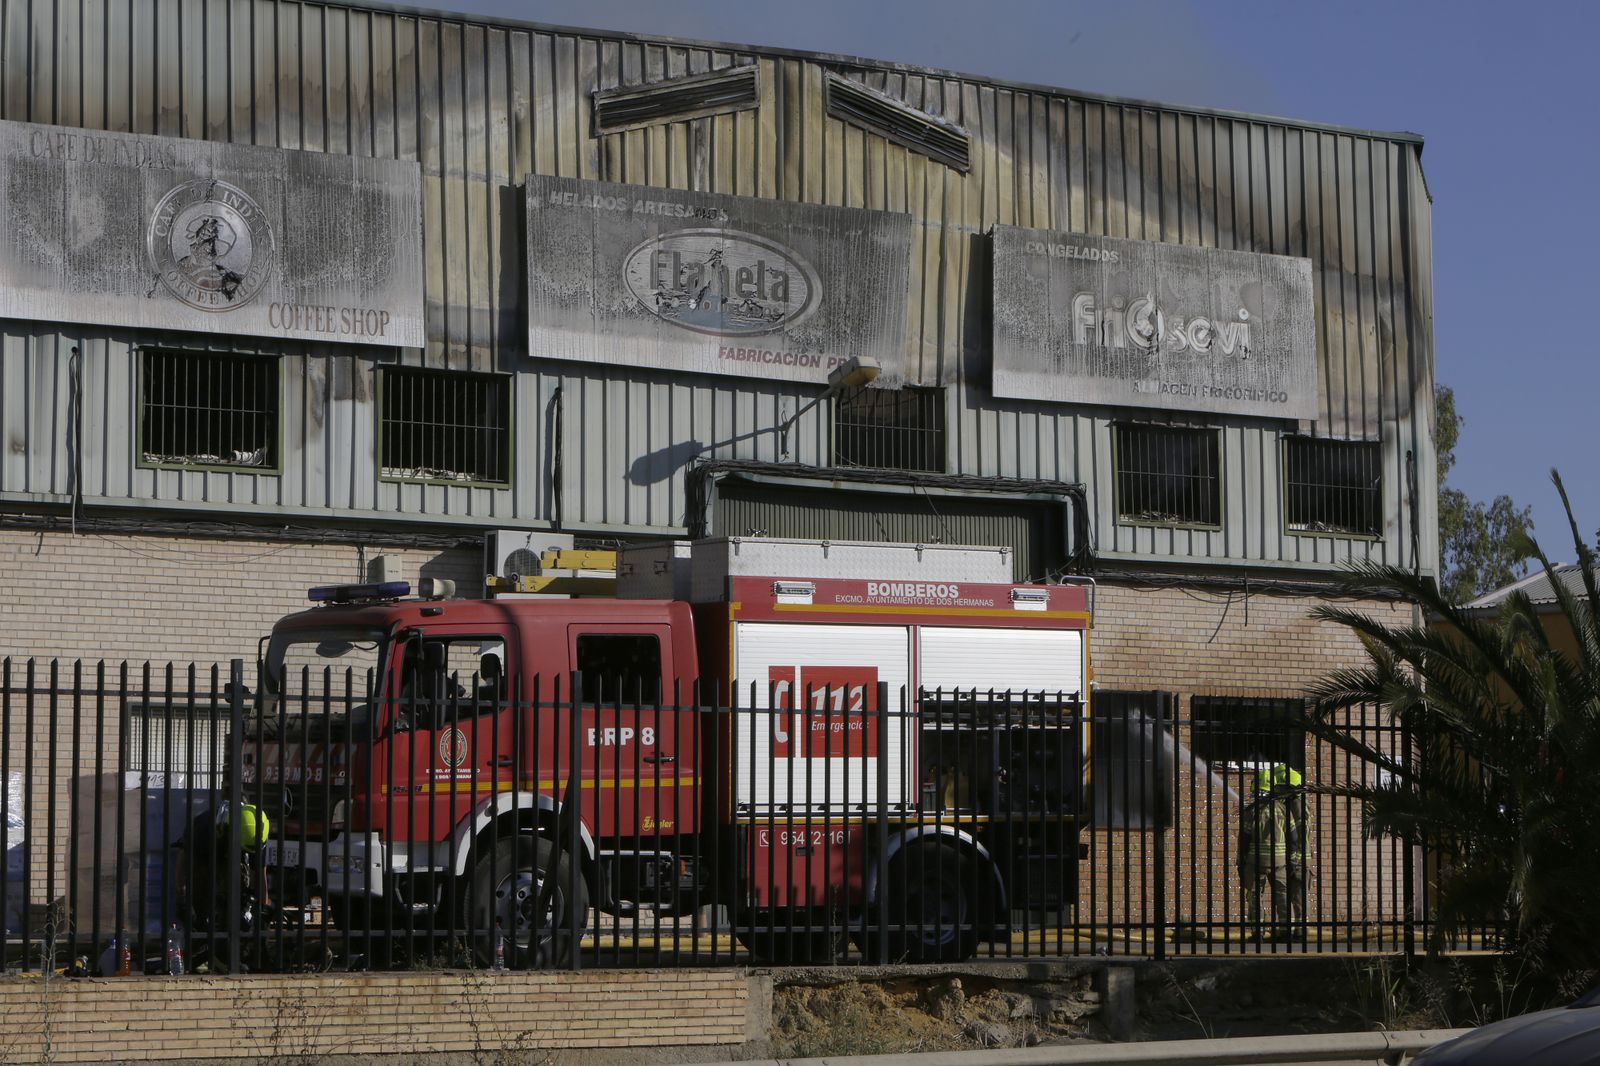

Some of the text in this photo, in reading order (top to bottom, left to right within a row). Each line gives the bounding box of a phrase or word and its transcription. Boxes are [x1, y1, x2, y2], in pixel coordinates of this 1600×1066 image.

[549, 190, 627, 212] HELADOS
[1025, 241, 1120, 263] CONGELADOS
[268, 301, 391, 338] COFFEE SHOP
[835, 595, 994, 608] EXCMO. AYUNTAMIENTO DE DOS HERMANAS
[867, 582, 959, 599] BOMBEROS
[810, 685, 865, 717] 112
[641, 726, 656, 746] 8
